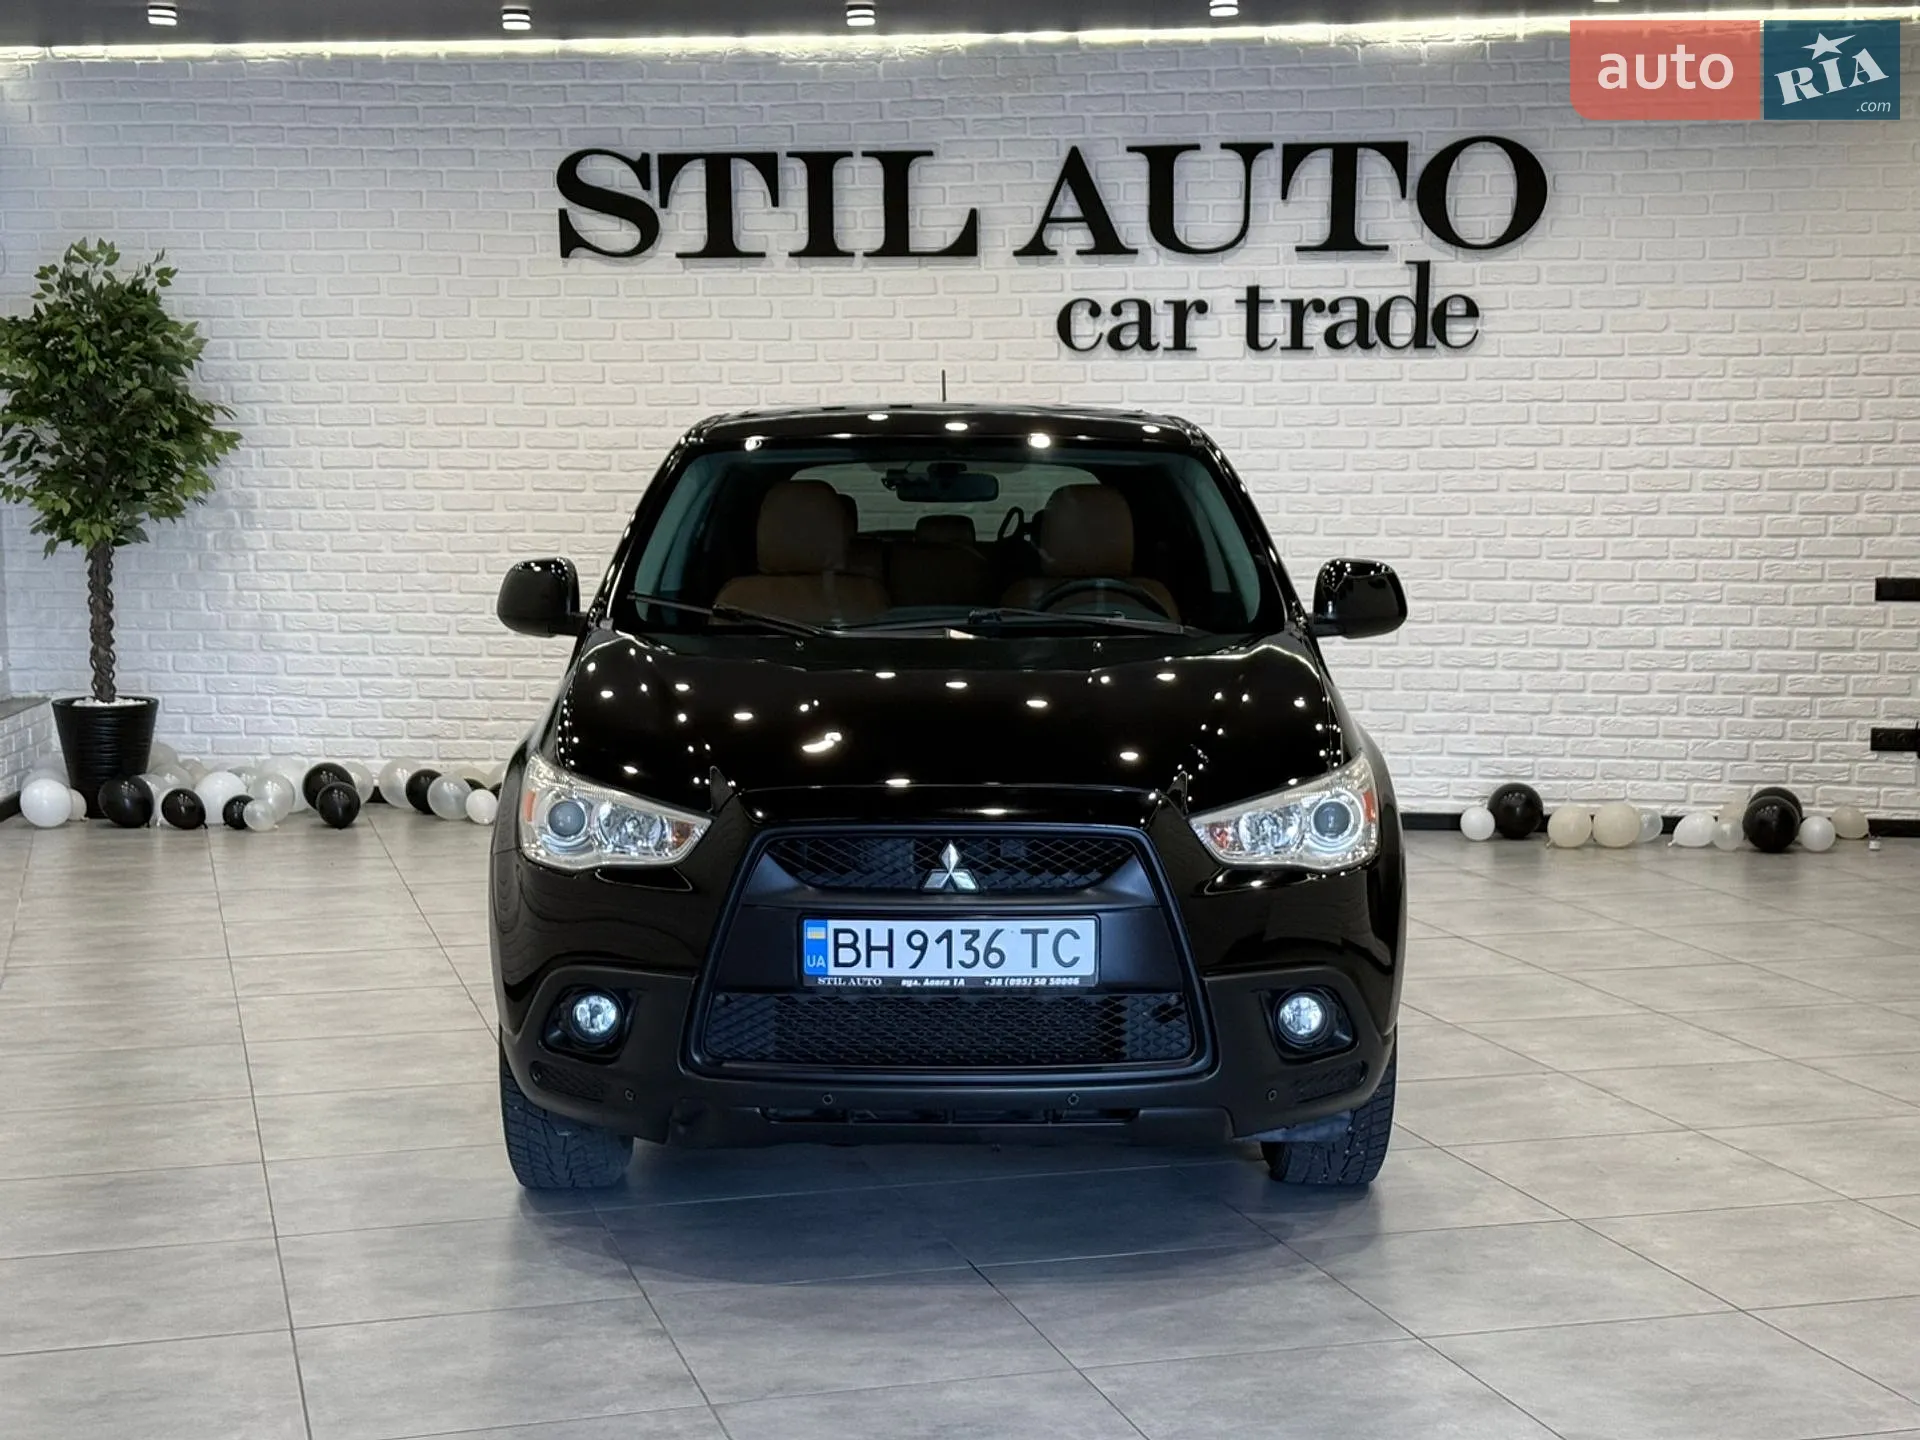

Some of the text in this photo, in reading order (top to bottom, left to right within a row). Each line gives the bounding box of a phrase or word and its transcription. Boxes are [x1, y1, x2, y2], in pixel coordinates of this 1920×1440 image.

[556, 136, 1549, 259] STIL AUTO
[1057, 260, 1481, 352] car trade
[806, 954, 827, 968] UA
[833, 928, 1081, 970] BH 9136 TC
[817, 976, 883, 987] STIL AUTO
